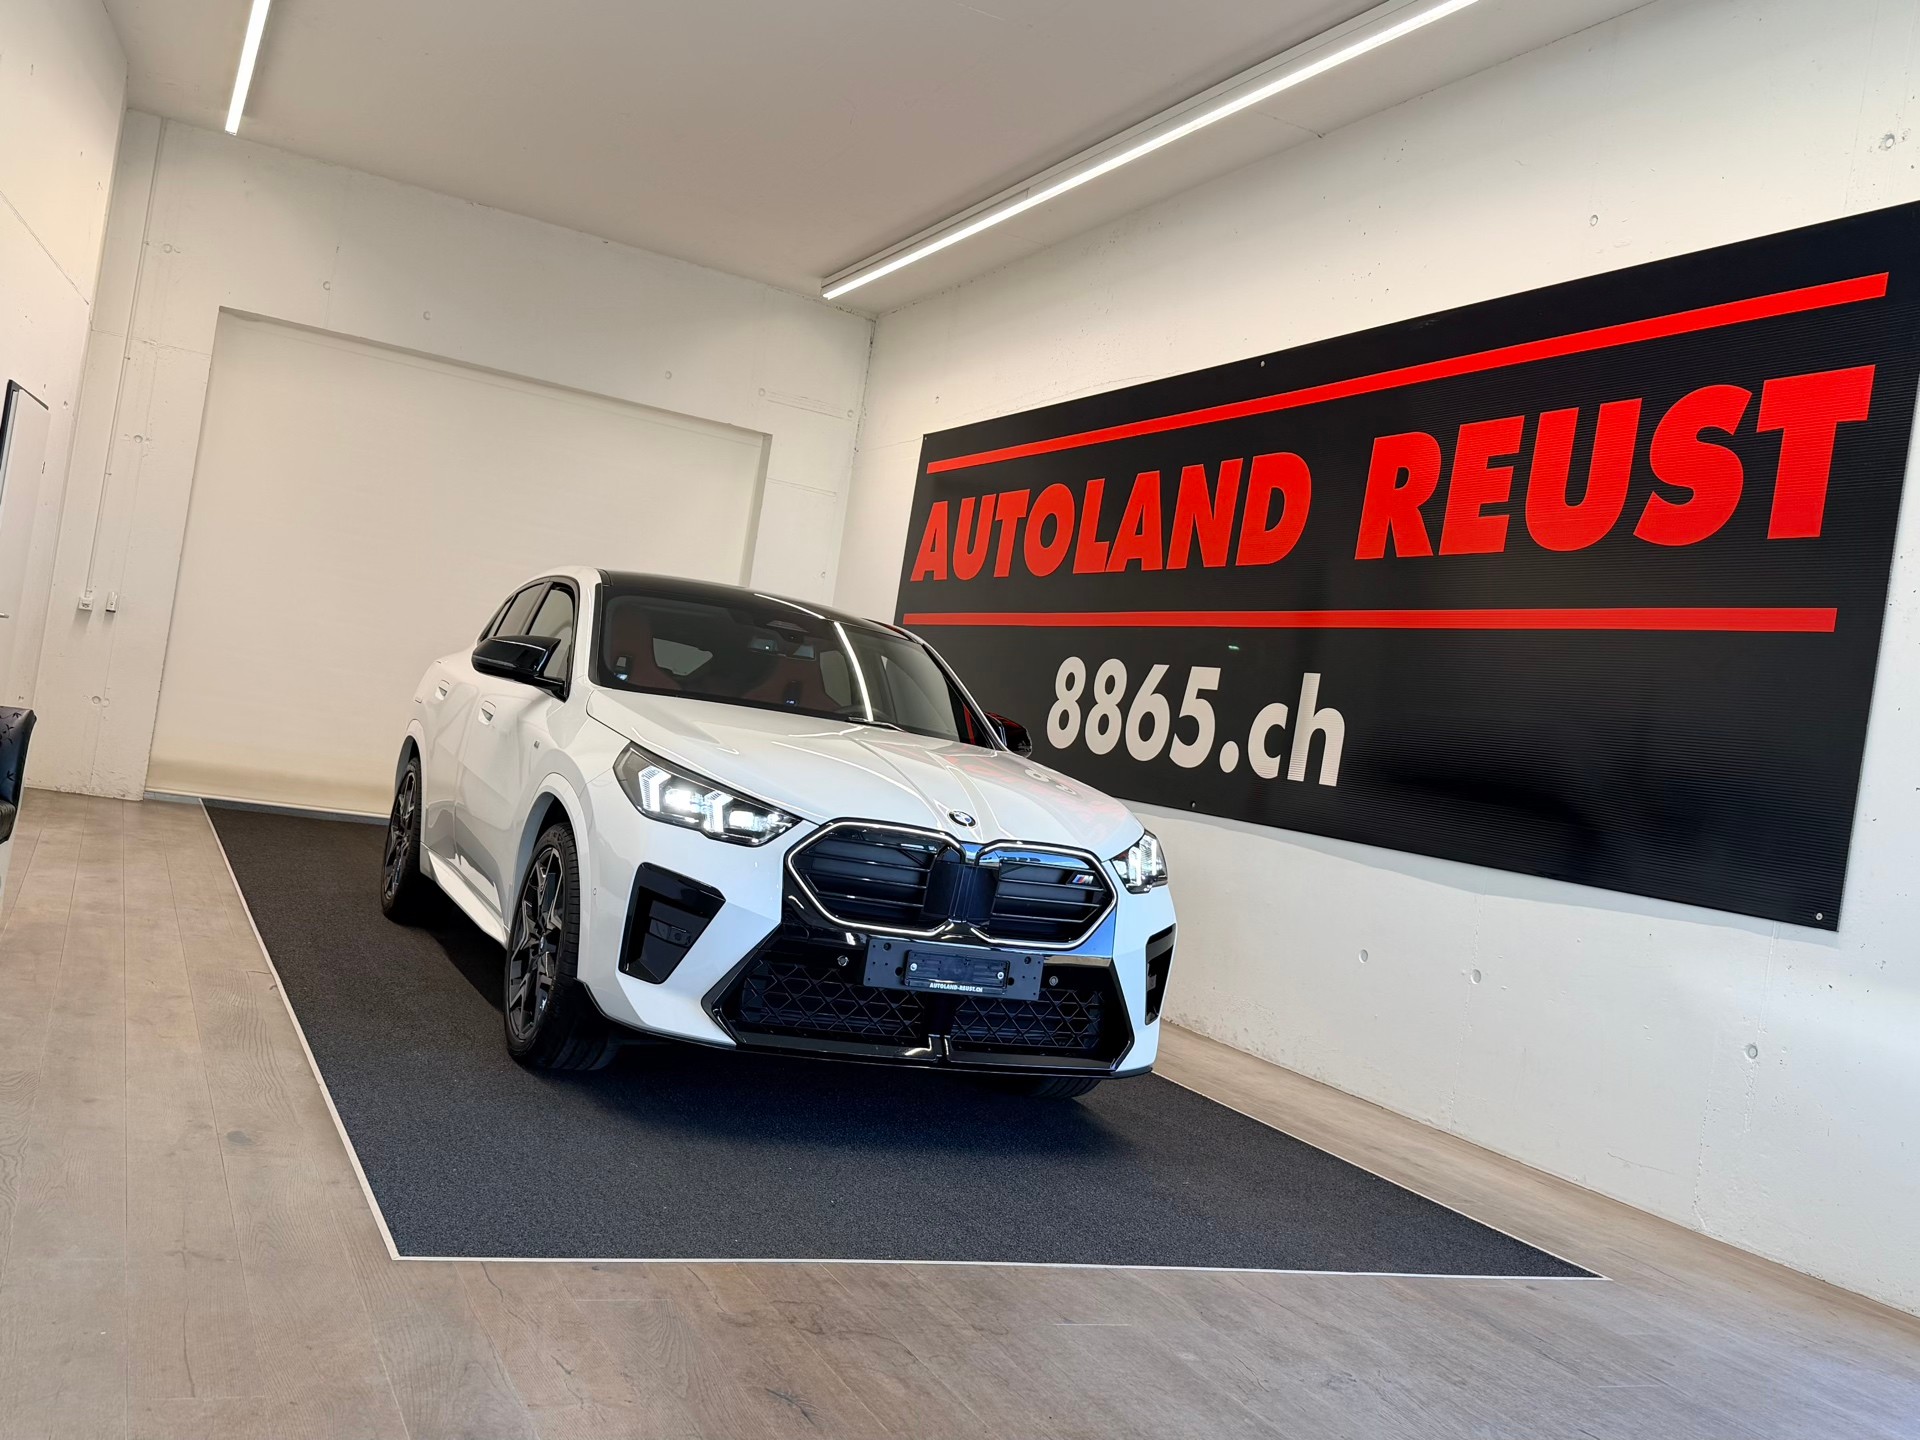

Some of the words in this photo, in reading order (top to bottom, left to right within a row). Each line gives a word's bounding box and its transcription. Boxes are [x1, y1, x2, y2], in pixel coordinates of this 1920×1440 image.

[910, 452, 1312, 582] AUTOLAND
[1354, 364, 1876, 560] REUST
[1046, 656, 1345, 787] 8865.ch
